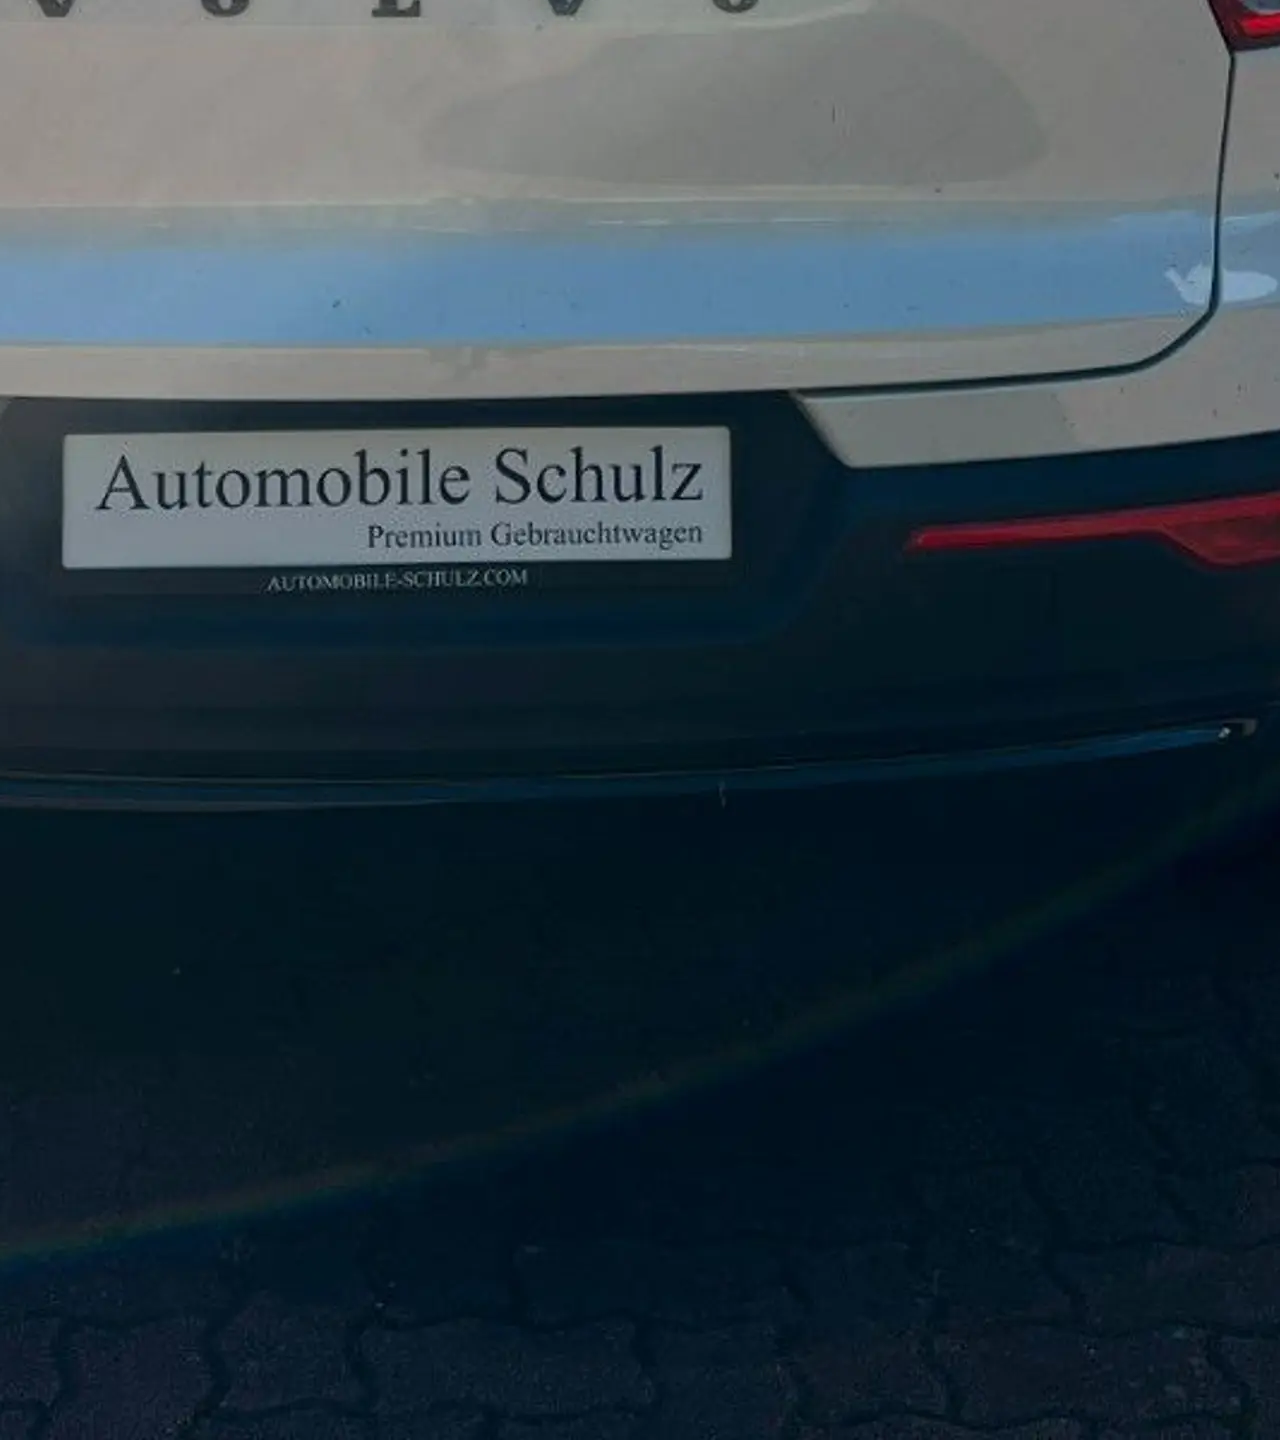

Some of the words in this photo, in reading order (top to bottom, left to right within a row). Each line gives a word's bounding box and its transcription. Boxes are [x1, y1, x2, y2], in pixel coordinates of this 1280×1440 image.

[94, 448, 471, 511] Automobile
[495, 444, 704, 505] Schulz
[367, 522, 482, 549] Premium
[490, 520, 704, 550] Gebrauchtwagen
[267, 568, 529, 593] AUTOMOBILE-SCHULZ.COM
